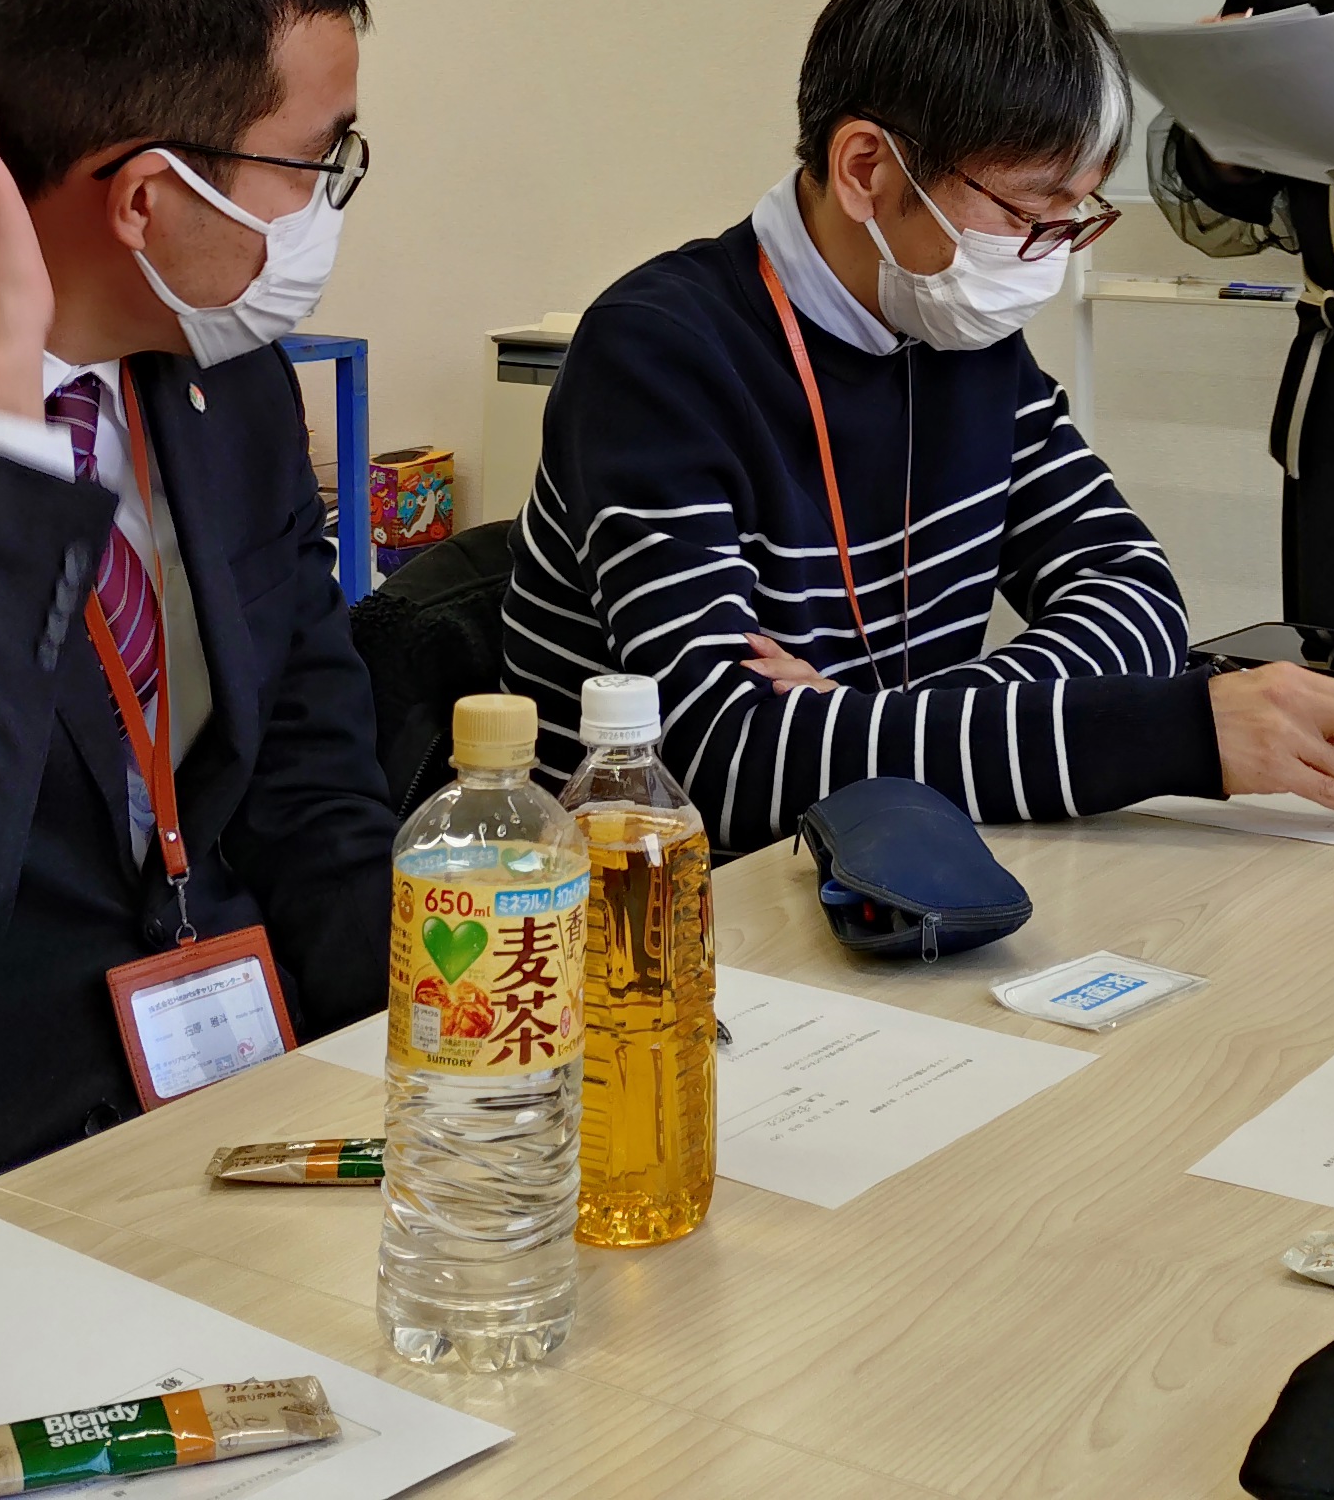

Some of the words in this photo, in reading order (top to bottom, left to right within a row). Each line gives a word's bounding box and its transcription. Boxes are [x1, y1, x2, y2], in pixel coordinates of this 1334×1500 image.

[487, 917, 560, 1066] 麦茶
[426, 1053, 473, 1068] SUNTORY
[43, 1403, 140, 1436] Blendy
[48, 1424, 113, 1448] stick
